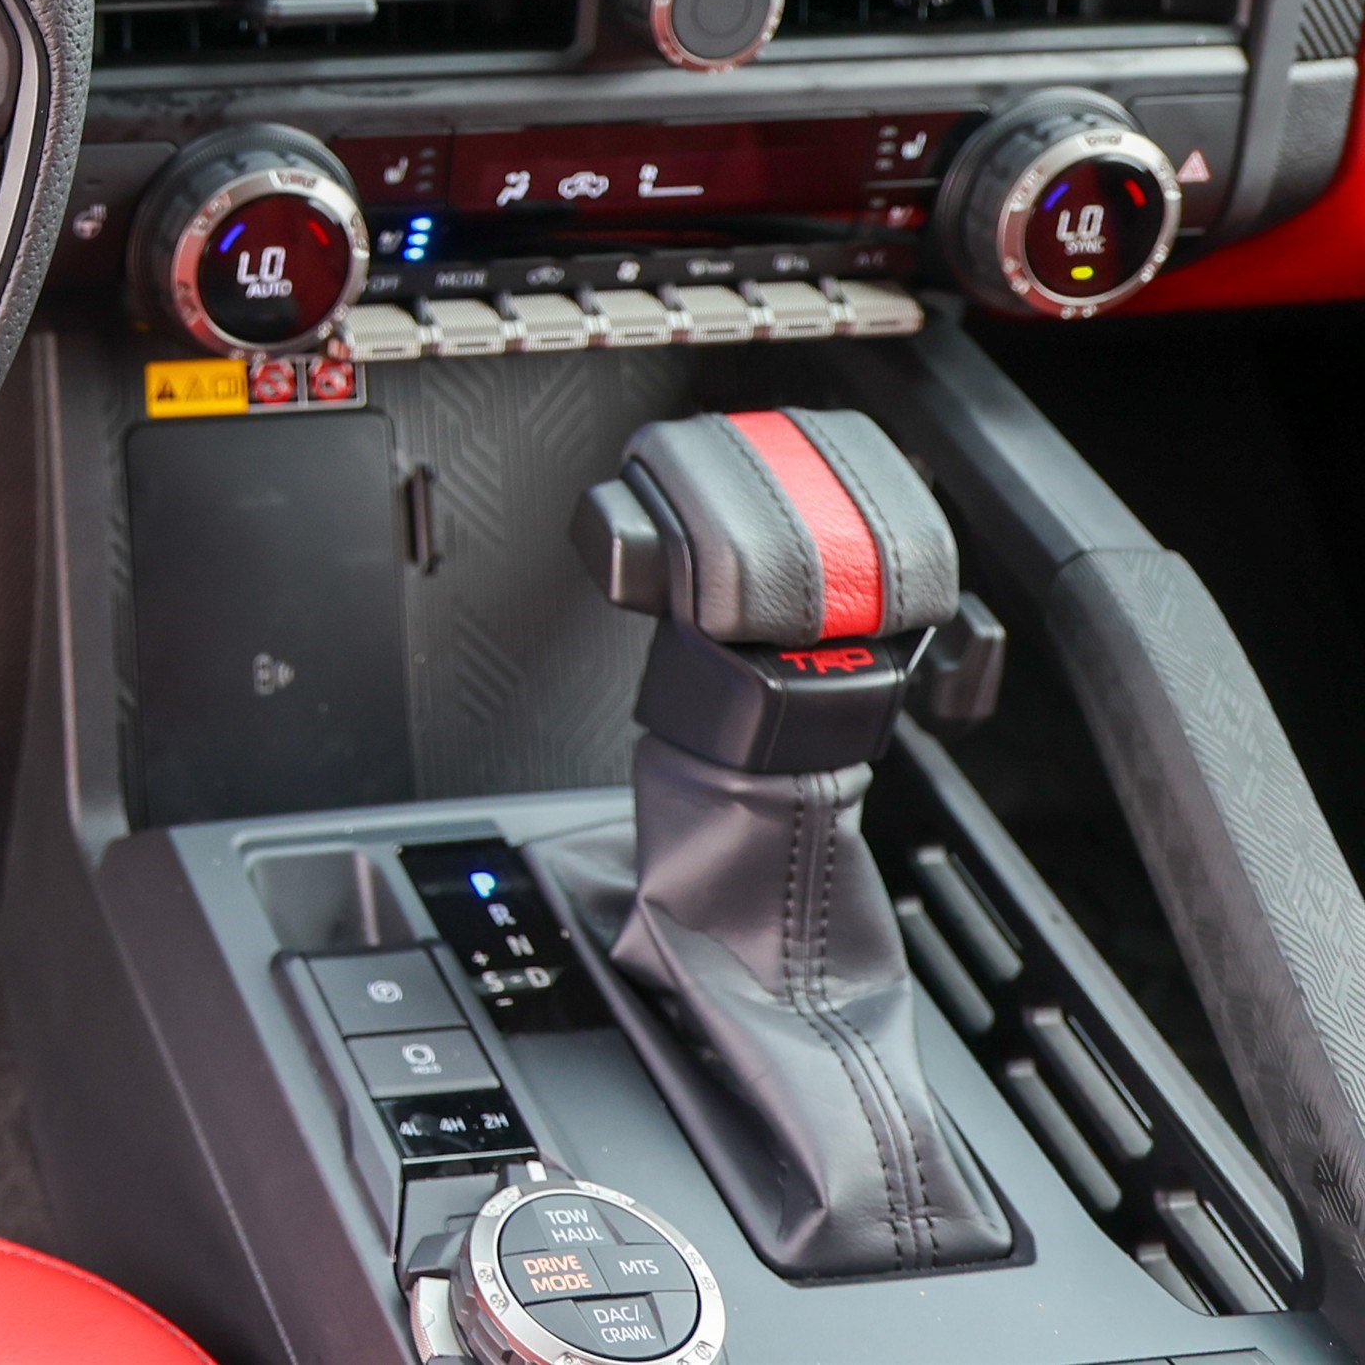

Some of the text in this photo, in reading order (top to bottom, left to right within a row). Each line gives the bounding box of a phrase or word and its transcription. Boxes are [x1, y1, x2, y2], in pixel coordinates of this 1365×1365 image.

[246, 279, 293, 298] AUTO
[778, 646, 875, 674] TRD
[470, 872, 496, 898] P
[487, 903, 517, 927] R
[506, 934, 535, 957] N
[482, 966, 551, 993] S D
[399, 1113, 510, 1136] 4L 4H 2H
[544, 1209, 589, 1225] TOW
[552, 1228, 604, 1244] HAUL
[523, 1255, 582, 1275] DRIVE
[619, 1259, 659, 1277] MTS
[530, 1274, 592, 1294] MODE
[593, 1306, 641, 1324] DAC/
[600, 1326, 657, 1344] CRAWL
